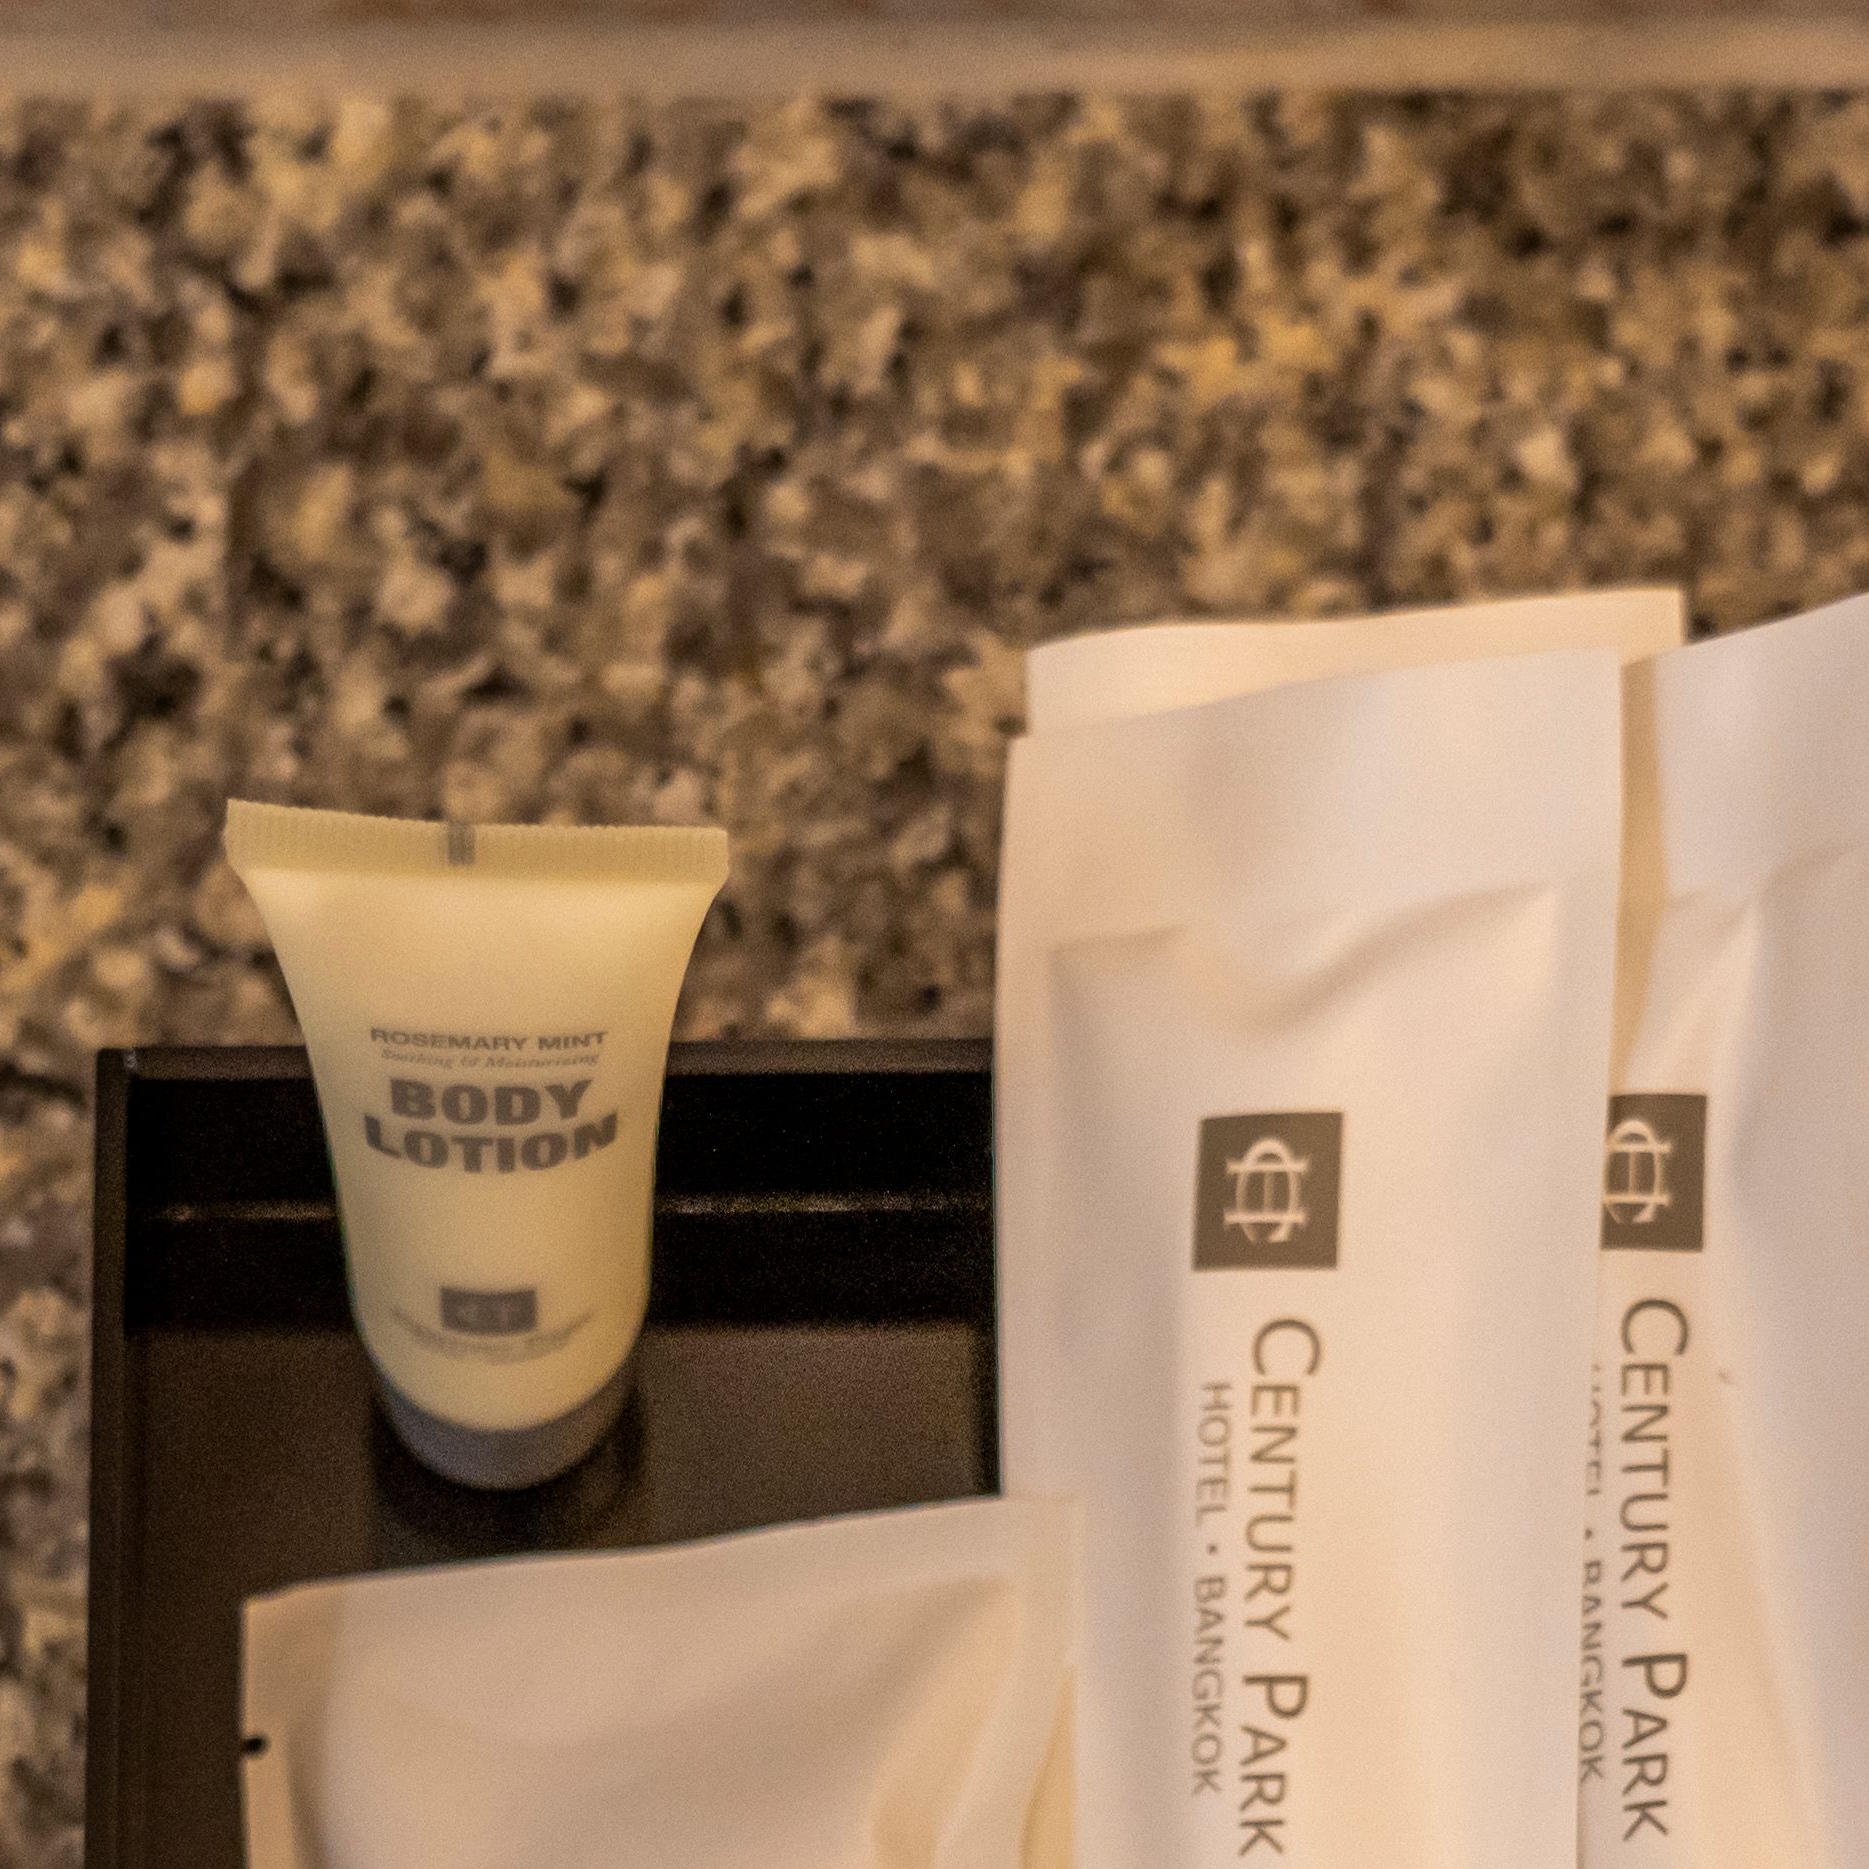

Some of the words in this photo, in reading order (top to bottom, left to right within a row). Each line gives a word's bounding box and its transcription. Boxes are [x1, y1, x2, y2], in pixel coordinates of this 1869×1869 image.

[370, 1028, 530, 1051] ROSEMARY
[538, 1031, 608, 1051] MINT
[390, 1079, 593, 1126] BODY
[364, 1110, 618, 1174] LOTION
[1195, 1382, 1231, 1527] HOTEL
[1191, 1575, 1227, 1796] BANGKOK
